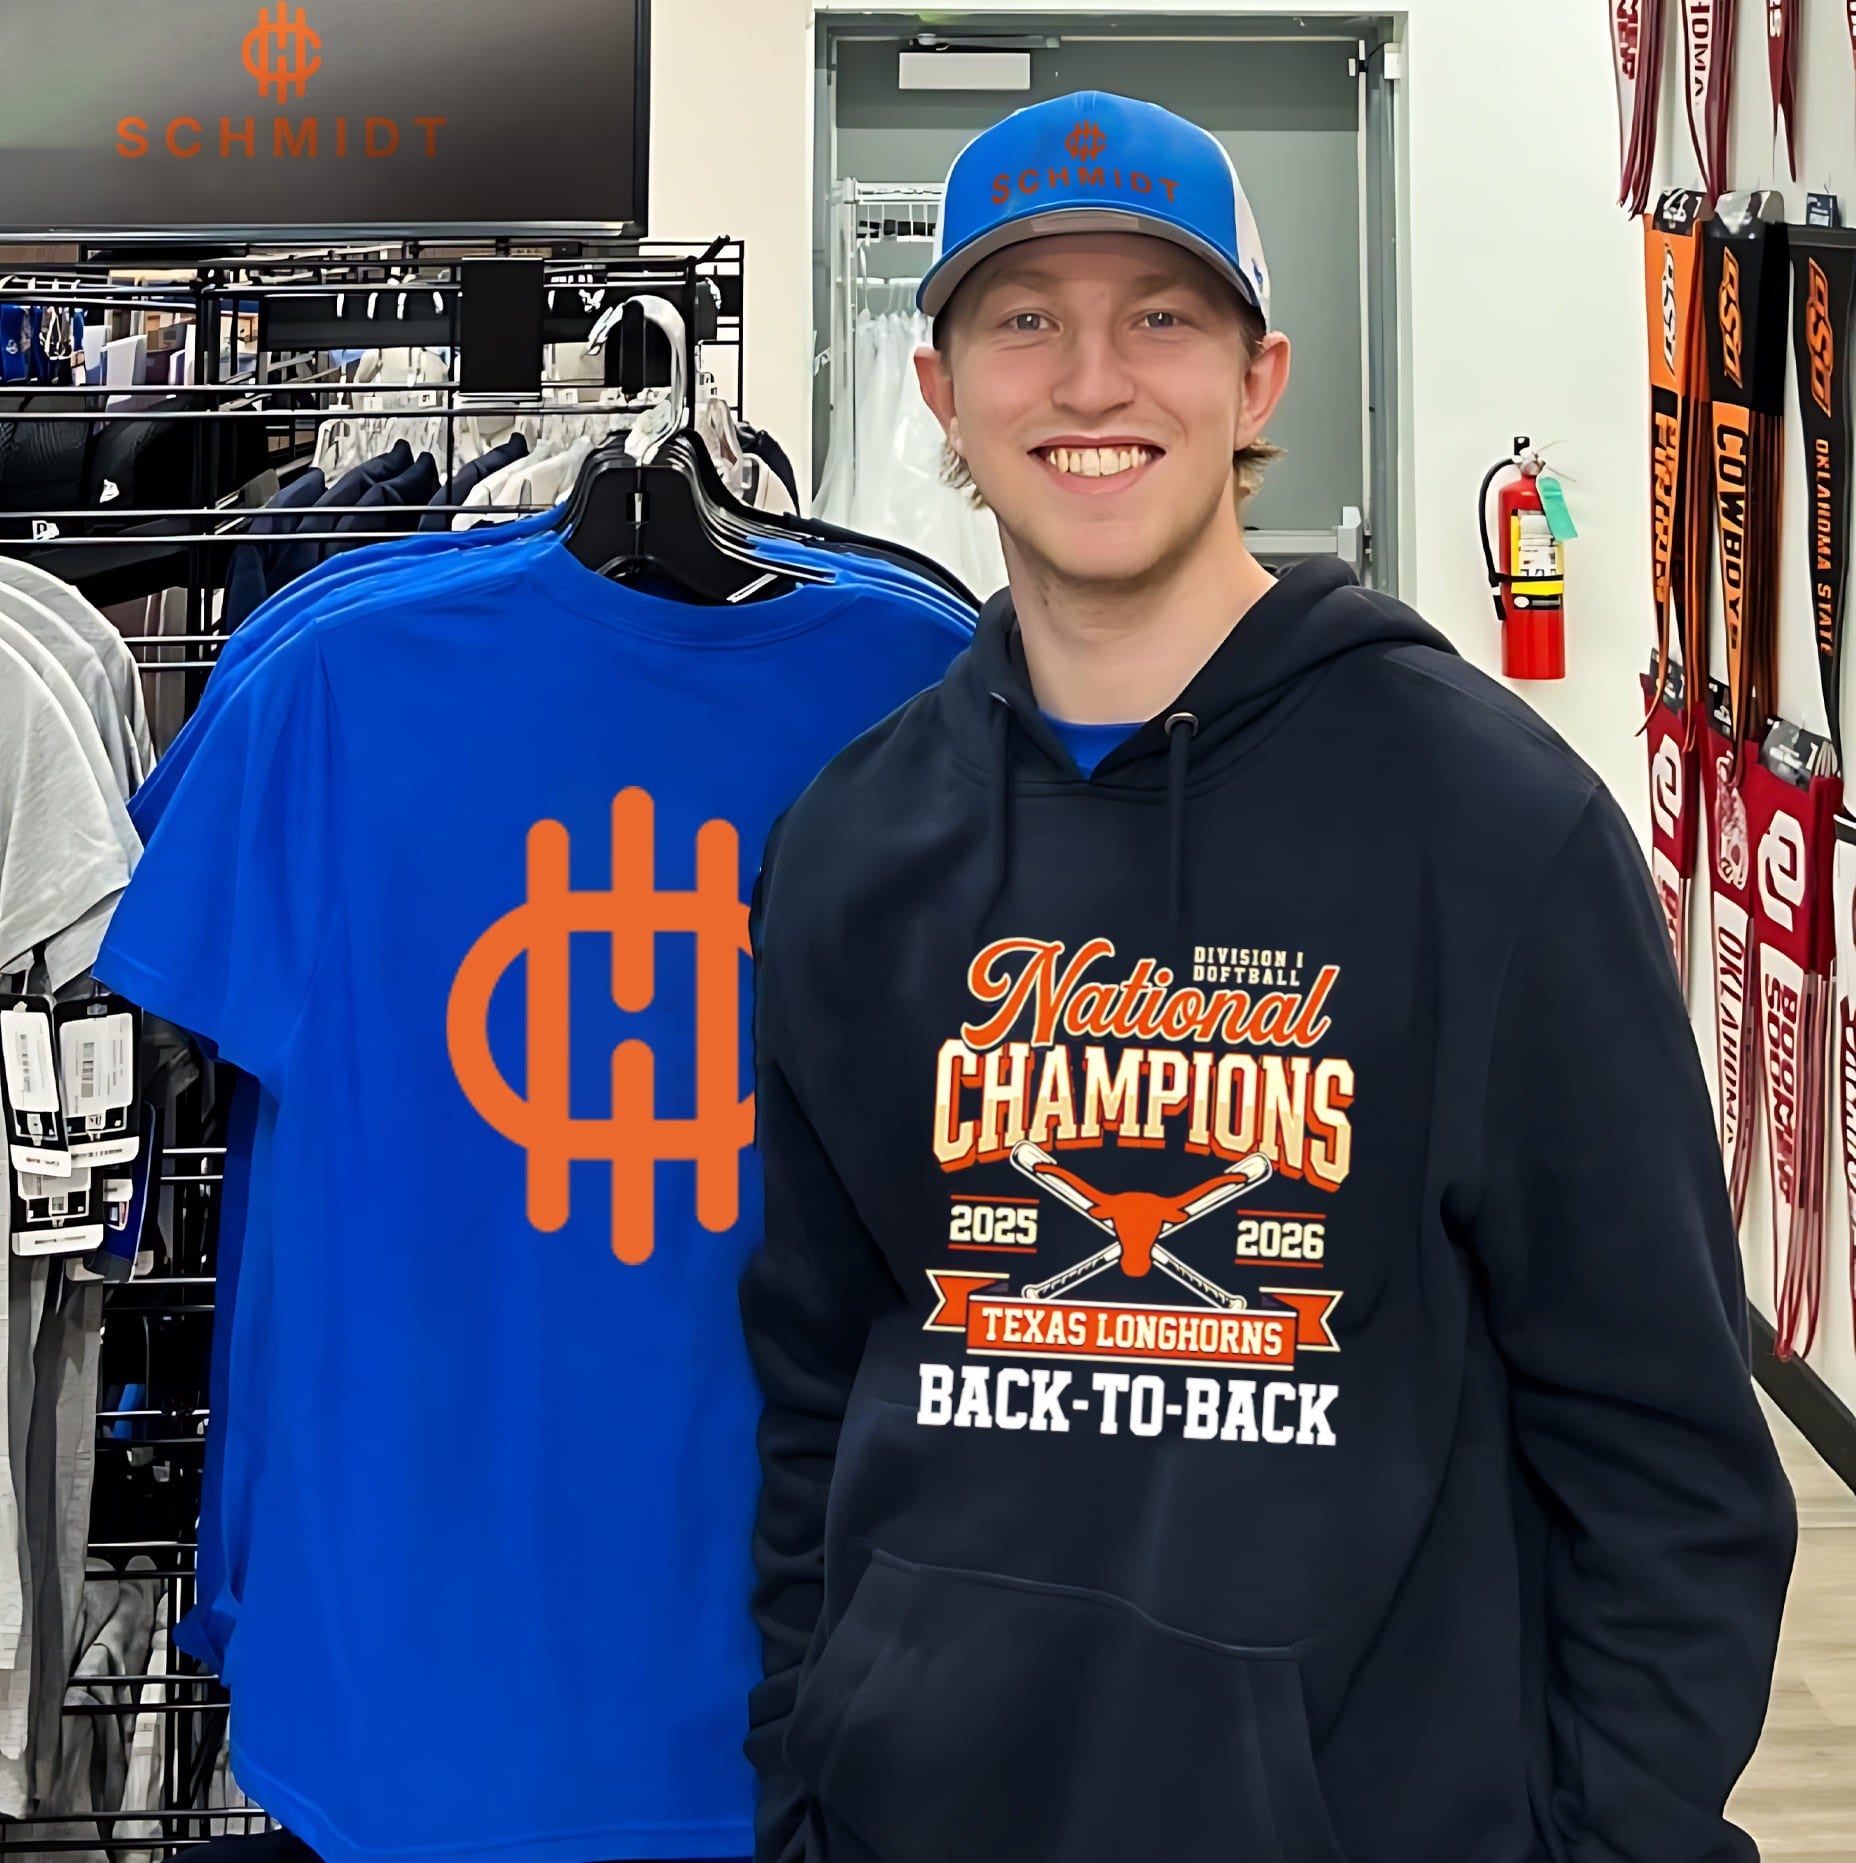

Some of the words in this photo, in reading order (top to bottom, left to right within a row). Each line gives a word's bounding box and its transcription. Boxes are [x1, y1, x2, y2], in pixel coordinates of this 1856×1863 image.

[115, 117, 447, 158] SCHMIDT
[991, 167, 1179, 205] SCHMIDT
[1815, 438, 1832, 571] OKLAHOMA
[1816, 583, 1833, 656] STATE
[961, 937, 1341, 1050] National
[1193, 945, 1287, 968] DIVISION
[1296, 951, 1304, 969] I
[1718, 926, 1745, 1144] OKLAHOMA
[932, 1038, 1355, 1192] CHAMPIONS
[949, 1205, 1038, 1245] 2025
[1236, 1220, 1325, 1259] 2026
[982, 1306, 1087, 1347] TEXAS
[1096, 1312, 1283, 1357] LONGHORNS
[917, 1363, 1339, 1446] BACK-TO-BACK
